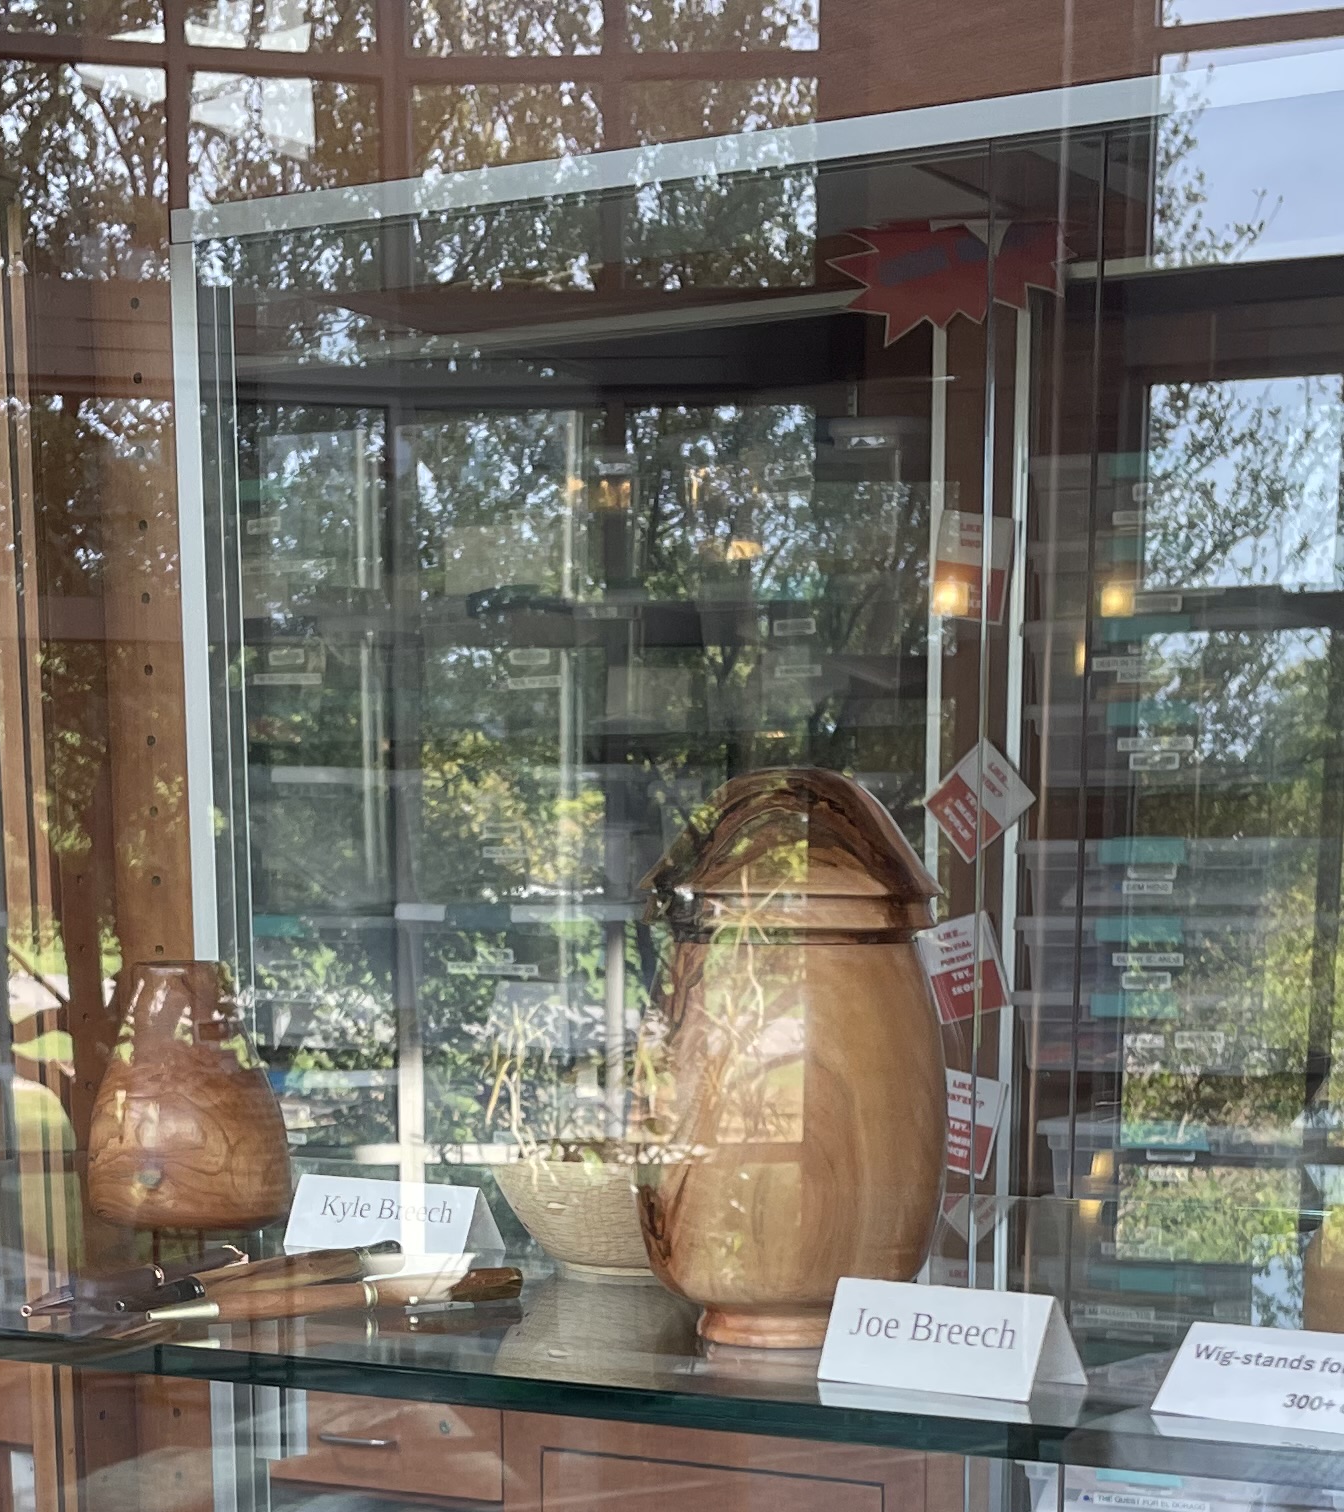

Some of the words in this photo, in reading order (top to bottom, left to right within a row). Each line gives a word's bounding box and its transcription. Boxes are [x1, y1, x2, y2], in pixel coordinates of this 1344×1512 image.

[320, 1194, 371, 1223] Kyle
[376, 1198, 453, 1224] Breech
[849, 1307, 900, 1338] Joe
[909, 1312, 1017, 1350] Breech
[1193, 1342, 1314, 1371] Wig-stands
[1282, 1392, 1336, 1411] 300+
